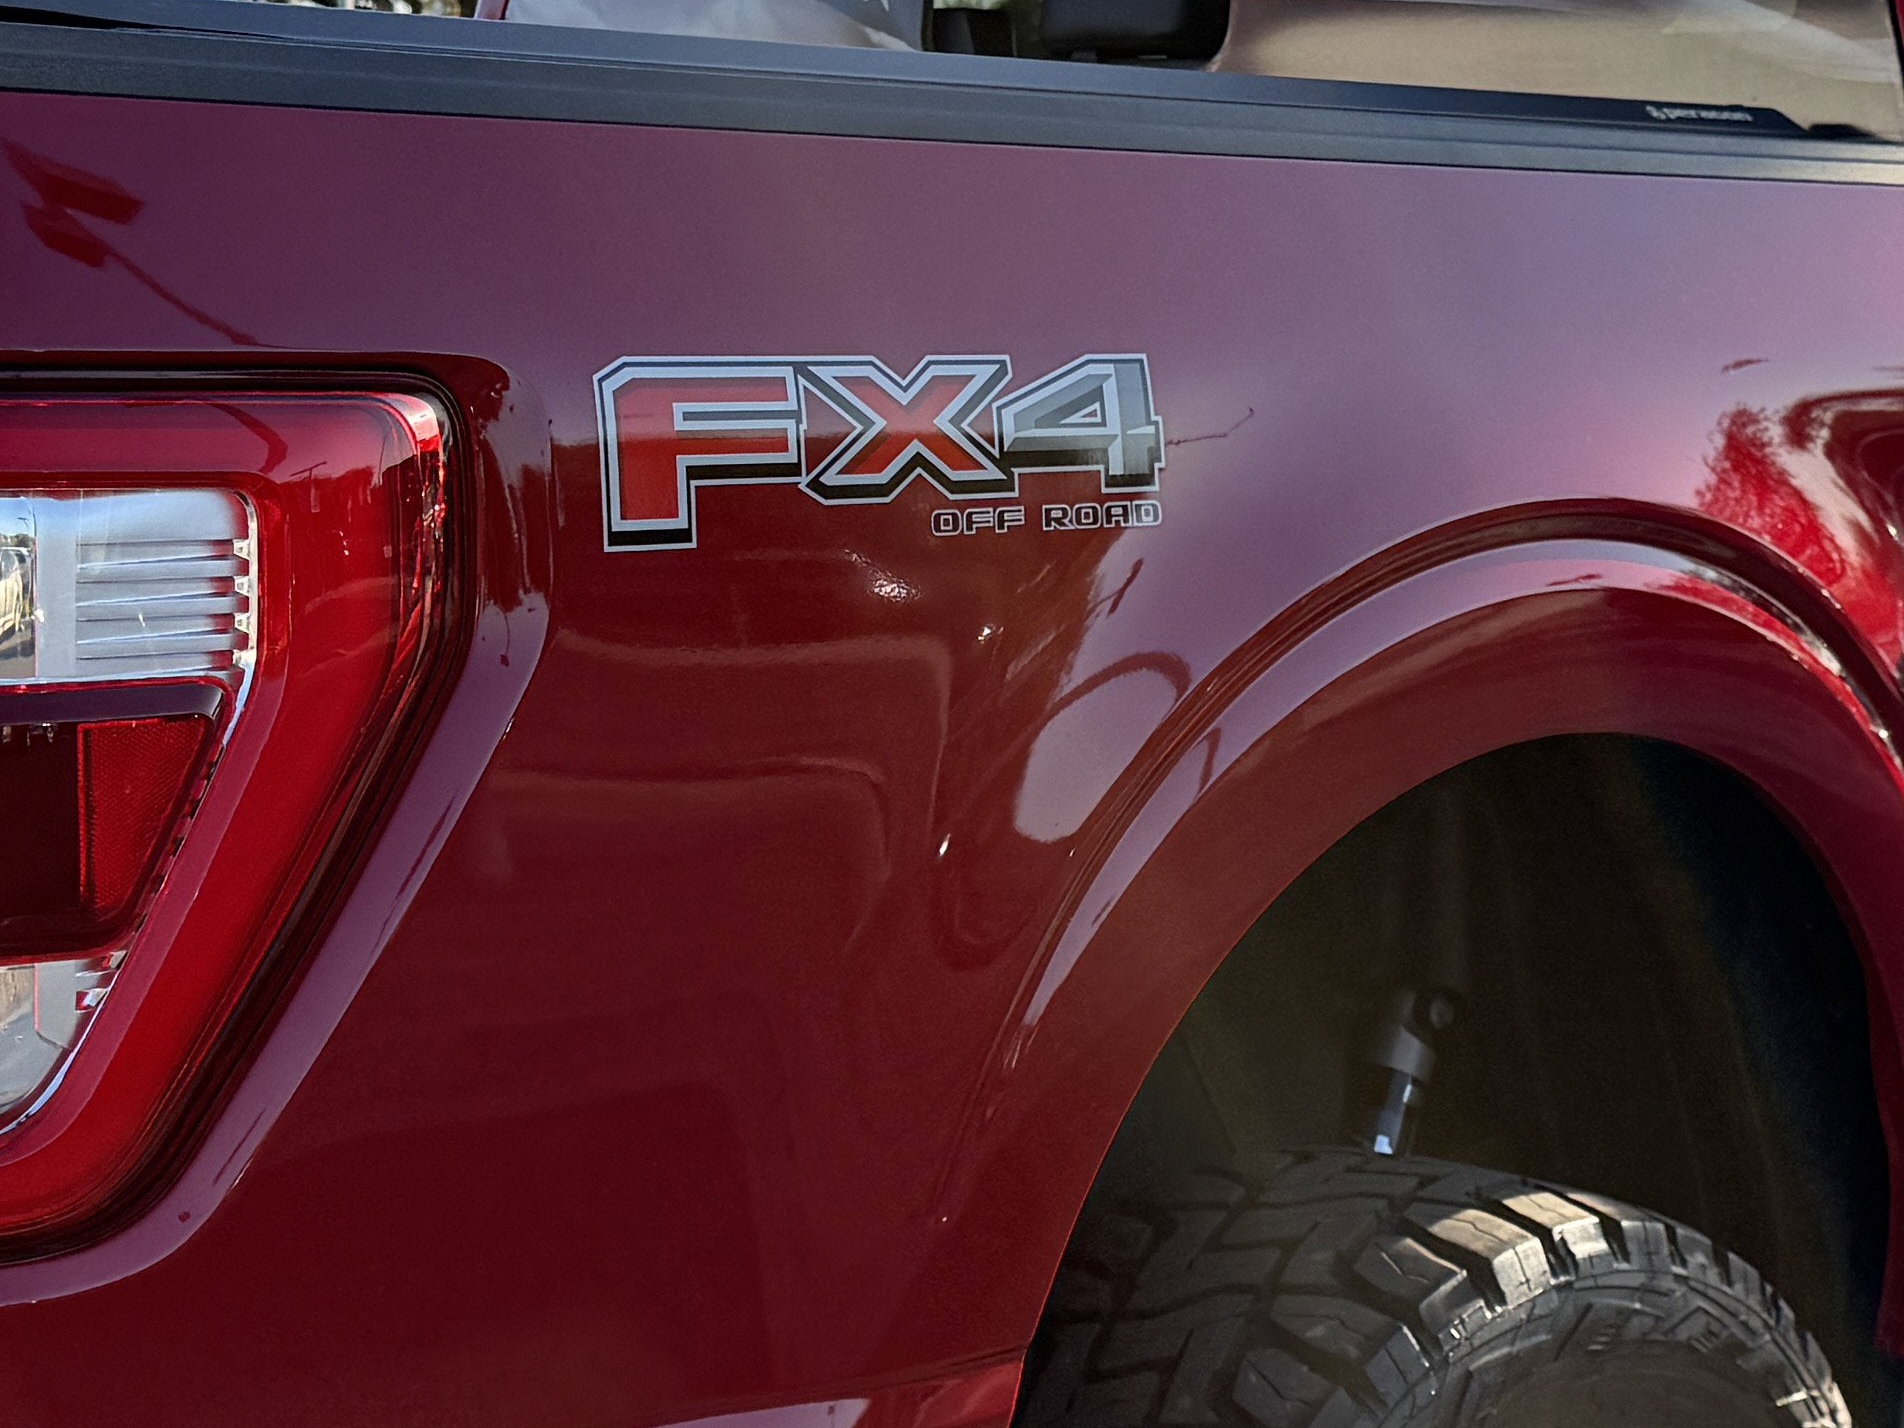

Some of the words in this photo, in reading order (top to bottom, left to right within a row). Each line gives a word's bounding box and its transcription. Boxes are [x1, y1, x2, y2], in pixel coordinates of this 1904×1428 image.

[593, 354, 1165, 553] FX4
[930, 505, 1026, 537] OFF
[1042, 499, 1163, 532] ROAD
